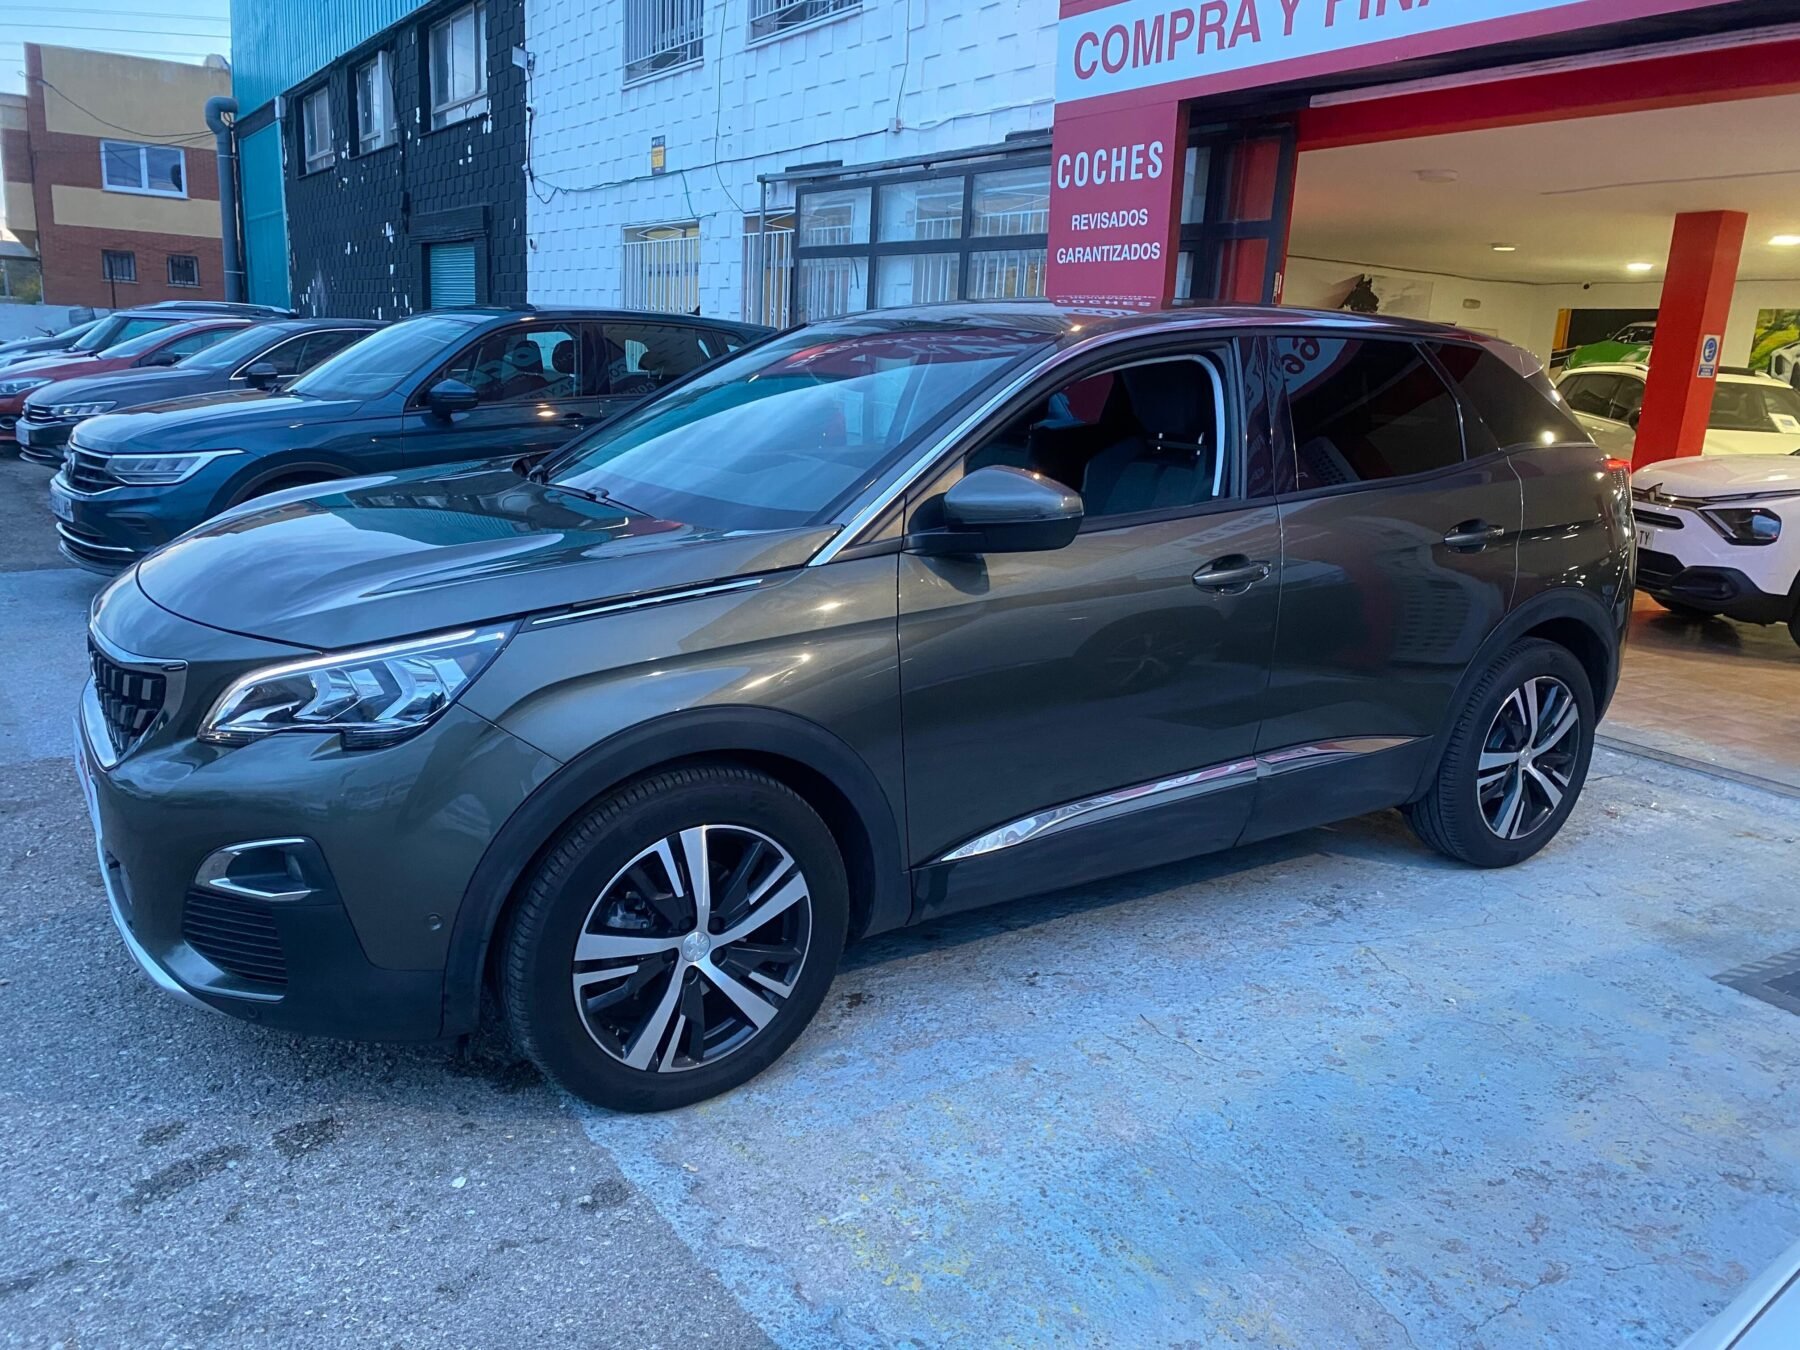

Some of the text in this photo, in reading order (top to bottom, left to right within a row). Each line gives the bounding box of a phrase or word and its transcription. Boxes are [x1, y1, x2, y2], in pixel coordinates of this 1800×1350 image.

[1074, 0, 1261, 80] COMPRA
[1280, 0, 1300, 36] Y
[1057, 141, 1163, 189] COCHES
[1071, 208, 1148, 231] REVISADOS
[1056, 243, 1161, 264] GARANTIZADOS
